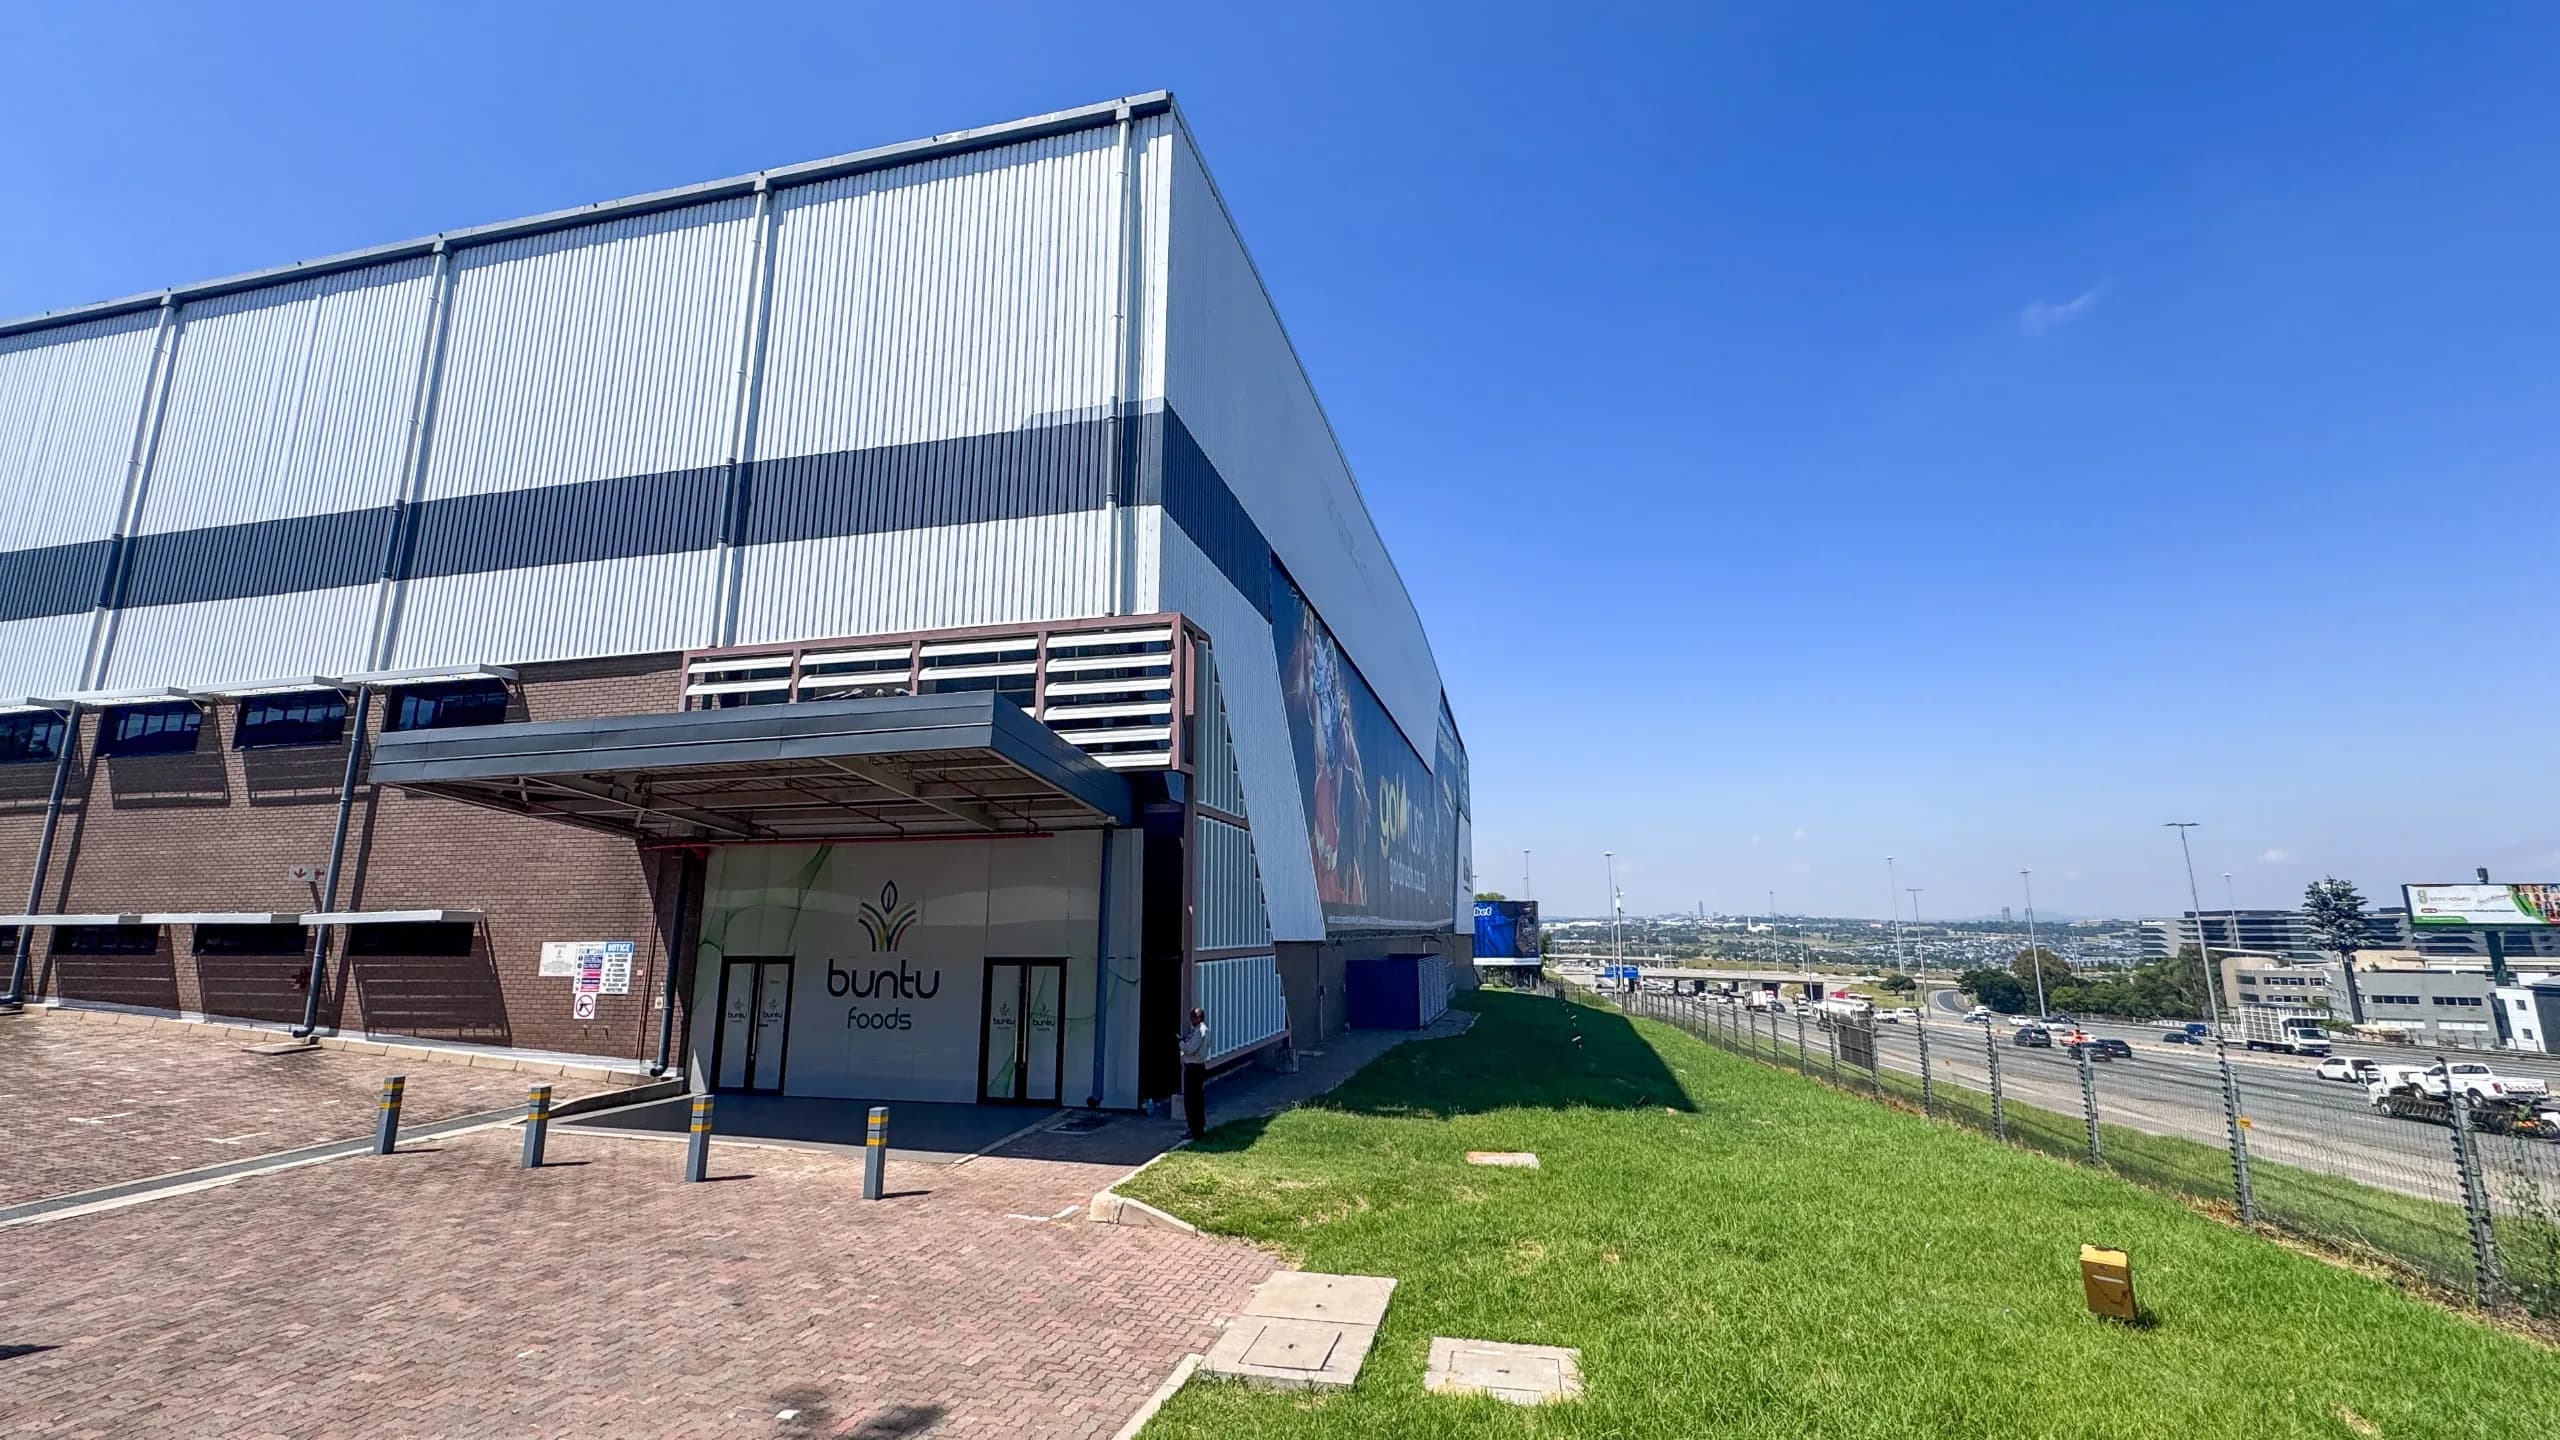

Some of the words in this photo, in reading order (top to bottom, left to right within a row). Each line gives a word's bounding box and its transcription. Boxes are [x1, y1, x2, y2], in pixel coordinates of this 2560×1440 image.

[608, 944, 631, 952] NOTICE
[827, 958, 940, 999] buntu
[847, 1006, 912, 1030] foods
